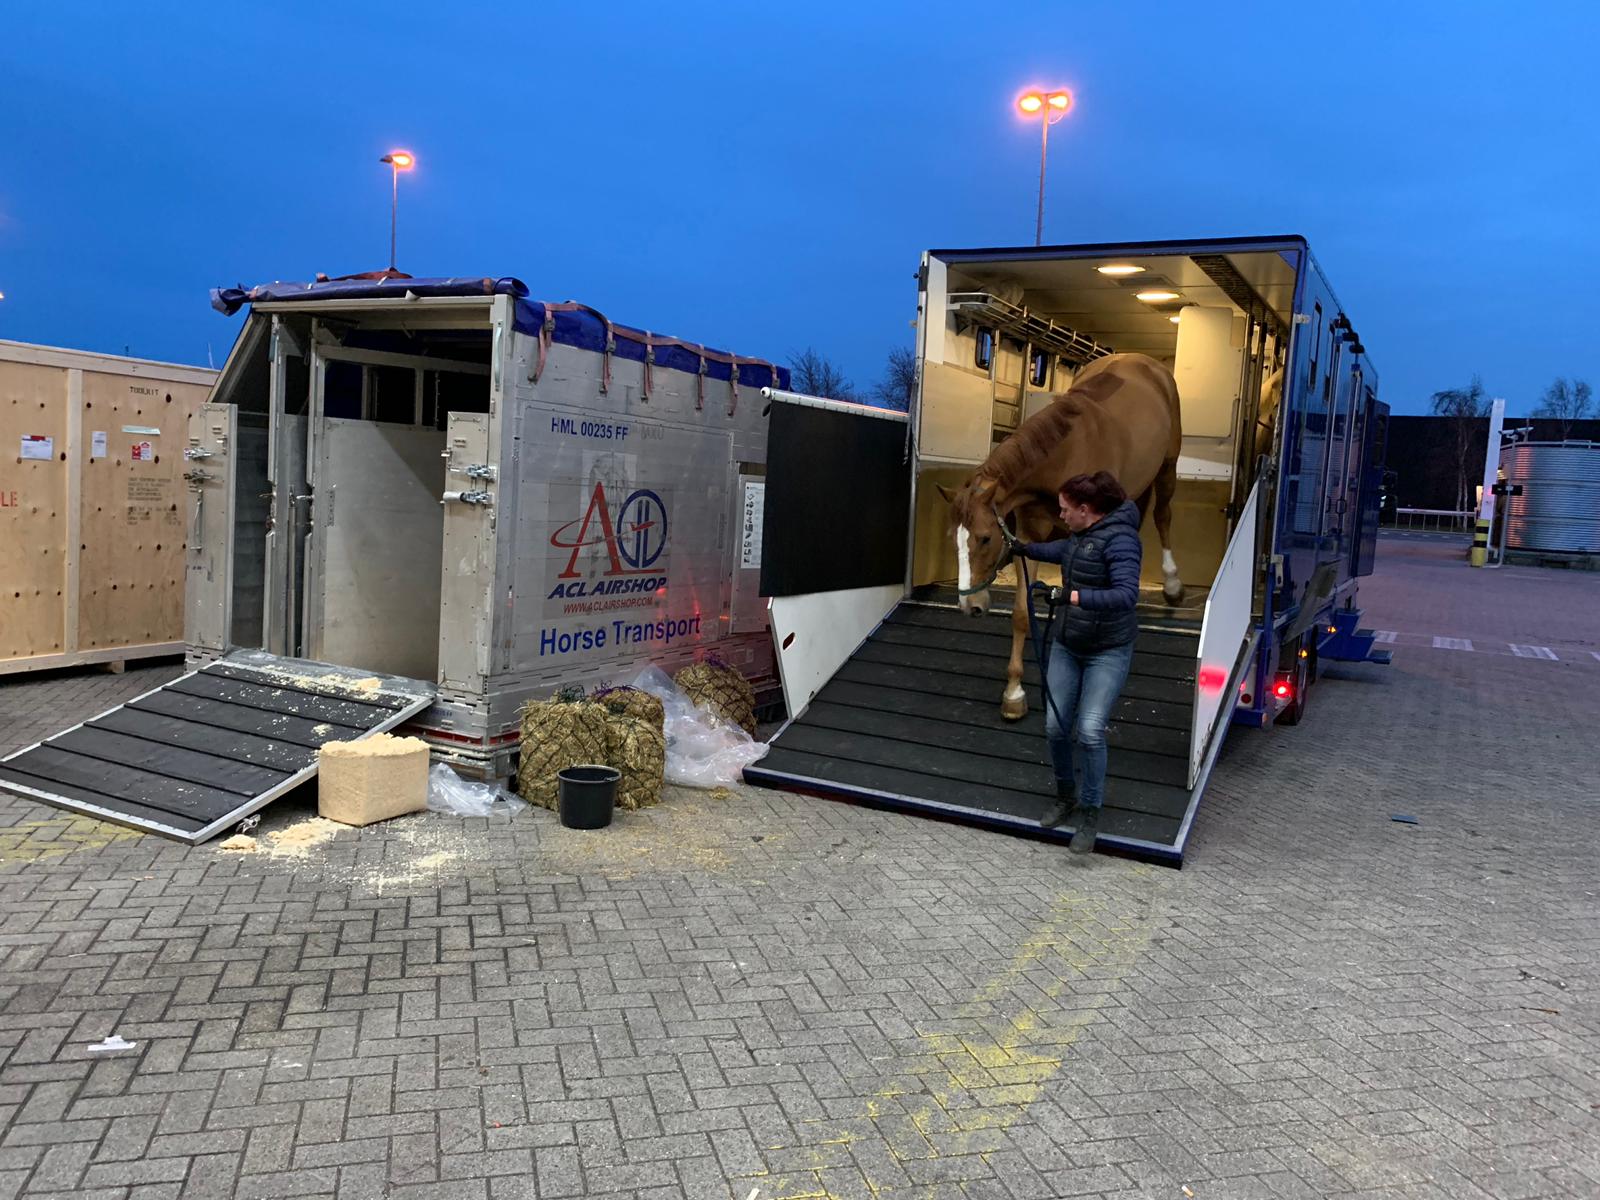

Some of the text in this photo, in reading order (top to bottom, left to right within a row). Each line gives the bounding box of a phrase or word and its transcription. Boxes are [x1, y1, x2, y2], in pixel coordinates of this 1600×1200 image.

[551, 417, 577, 435] HML
[581, 421, 613, 439] 00235
[615, 426, 629, 440] FF
[547, 576, 667, 600] ACL AIRSHOP
[563, 596, 653, 615] WWW.ACLAIRSHOP.COM
[540, 614, 701, 656] Horse Transport
